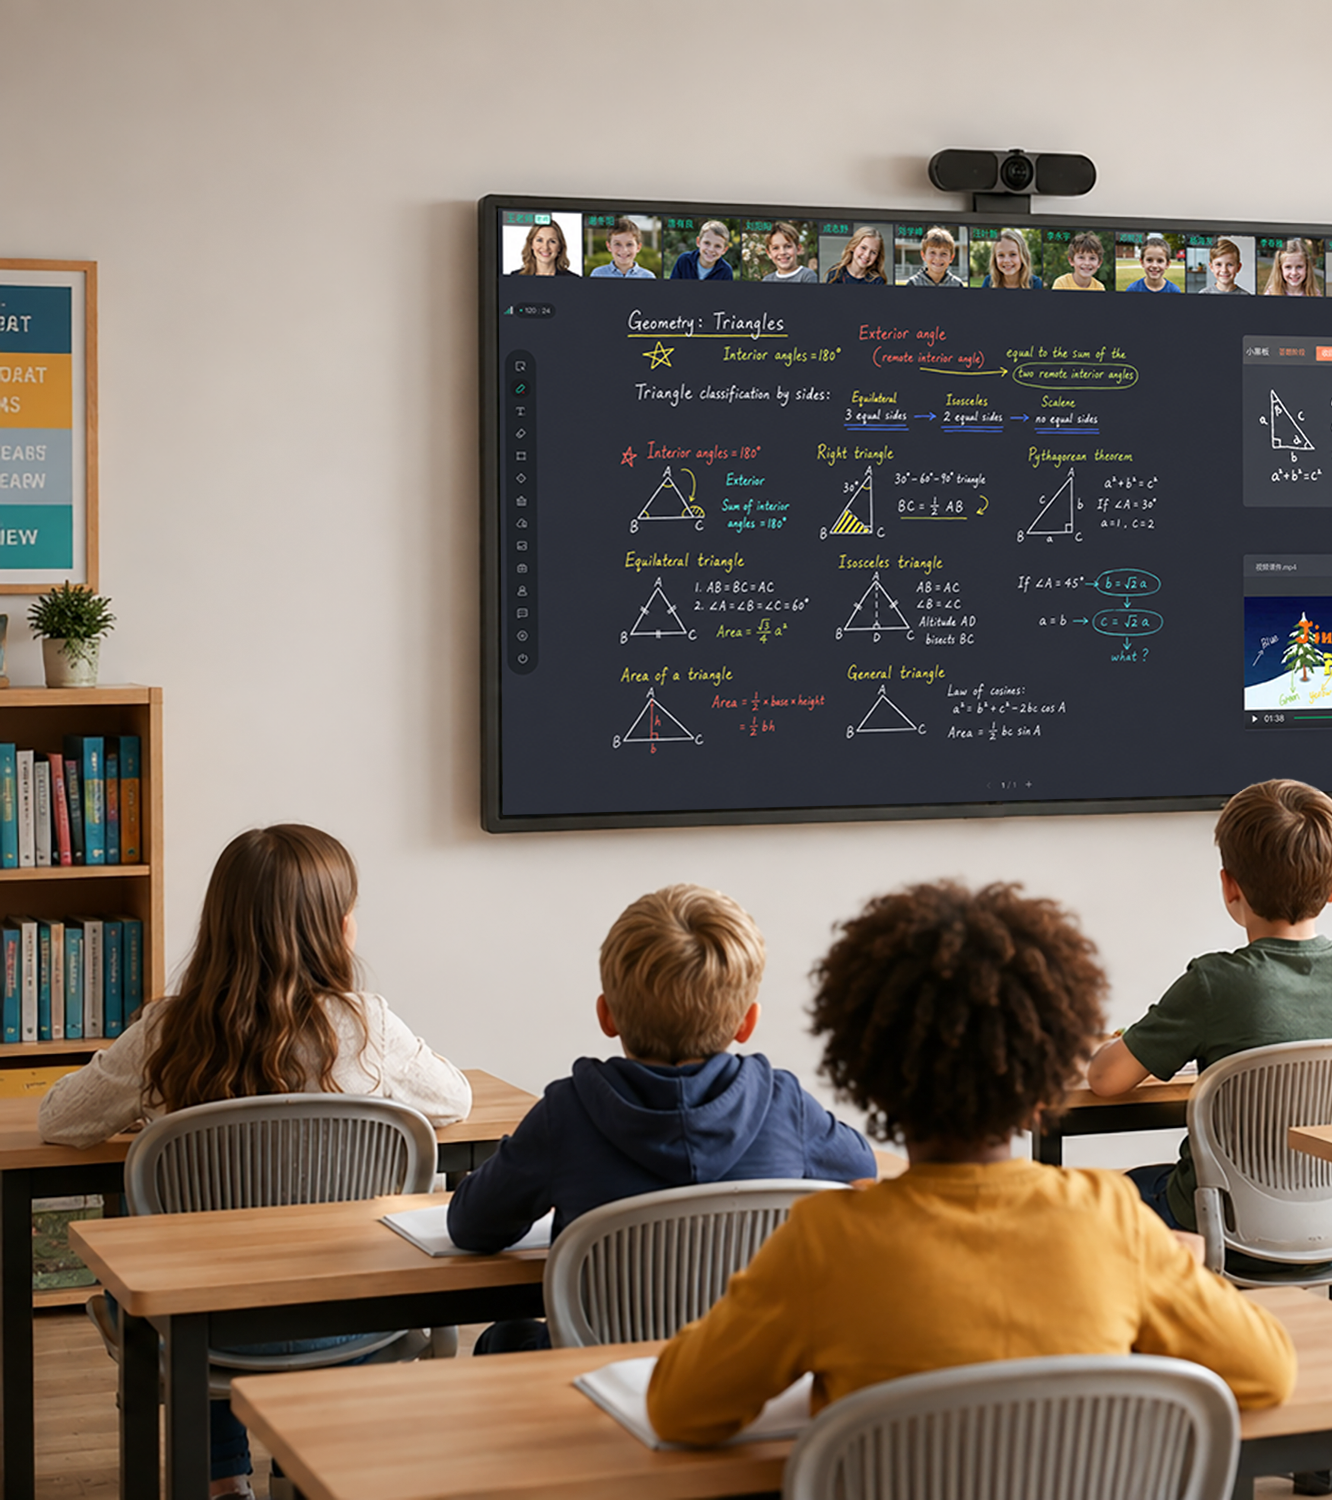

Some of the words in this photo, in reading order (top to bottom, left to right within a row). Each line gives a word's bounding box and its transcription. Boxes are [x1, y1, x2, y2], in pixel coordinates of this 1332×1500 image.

[713, 311, 784, 340] Triangles
[859, 325, 909, 341] Exterior
[916, 326, 947, 342] angle
[723, 347, 768, 361] Interior
[774, 346, 808, 366] angles
[918, 351, 954, 364] interior
[1006, 349, 1035, 364] equal
[1039, 348, 1048, 359] to
[1052, 347, 1069, 359] the
[1072, 350, 1091, 359] sum
[1096, 348, 1106, 362] of
[1111, 348, 1126, 359] the
[1018, 368, 1034, 379] two
[1039, 369, 1068, 379] remote
[1071, 369, 1104, 379] interior
[1108, 369, 1134, 384] angles
[636, 383, 693, 407] Triangle
[700, 385, 770, 401] classification
[777, 388, 790, 407] by
[796, 387, 831, 400] sides:
[852, 391, 897, 408] Equilateral
[946, 394, 988, 406] Isosceles
[1041, 396, 1076, 408] Scalene
[845, 410, 852, 421] 3
[856, 409, 881, 424] equal
[885, 411, 908, 421] sides
[944, 412, 951, 422] 2
[954, 411, 979, 426] equal
[982, 412, 1003, 422] sides
[1036, 416, 1046, 424] no
[1049, 414, 1074, 429] equal
[1078, 414, 1099, 425] sides
[647, 441, 691, 460] Interior
[696, 445, 729, 465] angles
[817, 443, 847, 466] Right
[855, 445, 894, 465] triangle
[1028, 446, 1086, 468] Pythagorean
[1095, 450, 1133, 462] theorem
[726, 473, 765, 486] Exterior
[957, 475, 986, 488] triangle
[721, 501, 737, 511] Sum
[741, 499, 753, 515] of
[757, 501, 789, 511] interior
[898, 499, 915, 512] BC
[946, 500, 964, 513] AB
[1097, 498, 1109, 511] If
[727, 518, 756, 533] angles
[625, 551, 689, 572] Equilateral
[698, 552, 745, 573] triangle
[838, 554, 889, 569] Isosceles
[898, 555, 943, 575] triangle
[1018, 576, 1031, 592] If
[919, 616, 956, 627] Altitude
[961, 616, 976, 626] AD
[716, 625, 742, 638] Area
[926, 634, 955, 645] bisects
[960, 634, 974, 644] BC
[1111, 650, 1137, 662] what
[621, 668, 649, 682] Area
[655, 667, 669, 685] of
[673, 673, 680, 681] a
[688, 666, 733, 686] triangle
[848, 664, 892, 681] General
[900, 665, 946, 685] triangle
[947, 684, 968, 696] Law
[973, 683, 985, 699] of
[712, 695, 738, 709] Area
[948, 726, 973, 738] Area
